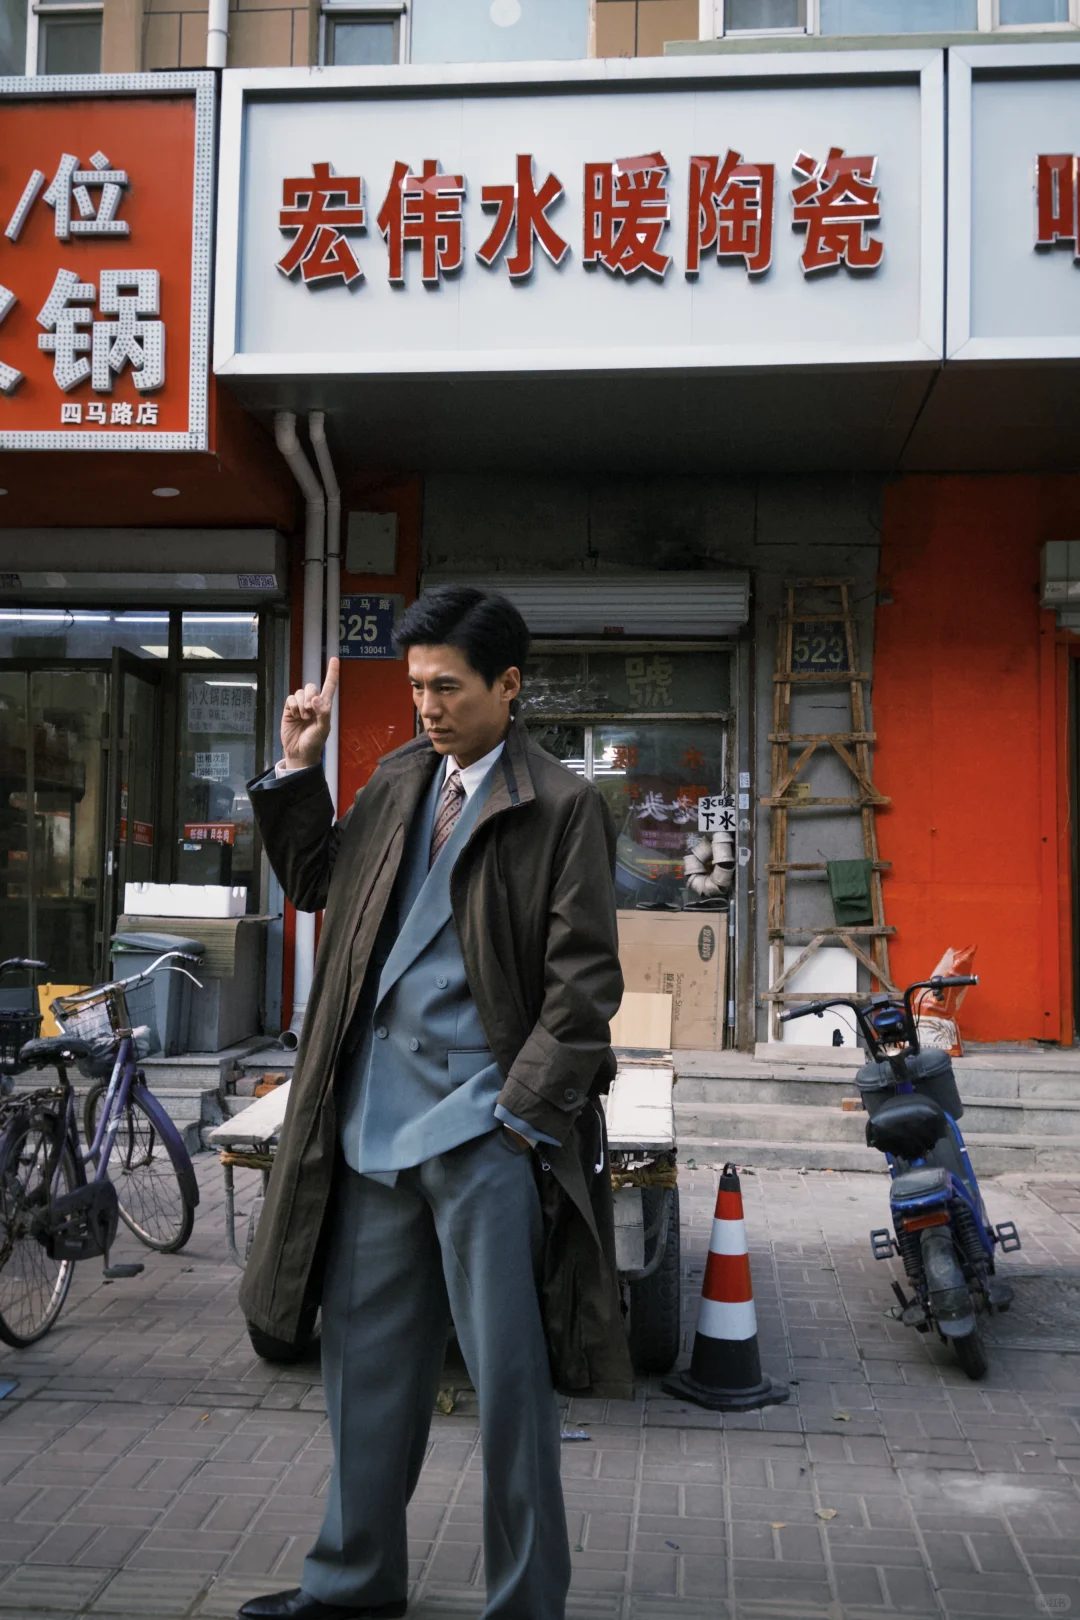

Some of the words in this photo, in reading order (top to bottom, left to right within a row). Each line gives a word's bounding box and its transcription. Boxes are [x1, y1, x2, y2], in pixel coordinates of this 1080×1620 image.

[275, 147, 884, 289] 宏伟水暖陶瓷
[0, 268, 166, 393] 锅
[60, 402, 159, 425] 四马路店
[360, 646, 386, 654] 130041
[794, 636, 844, 663] 523
[189, 686, 253, 708] 小火锅店招聘
[700, 795, 736, 810] 水暖
[701, 810, 736, 830] 下水
[676, 972, 684, 998] Source
[675, 1000, 683, 1021] Stone
